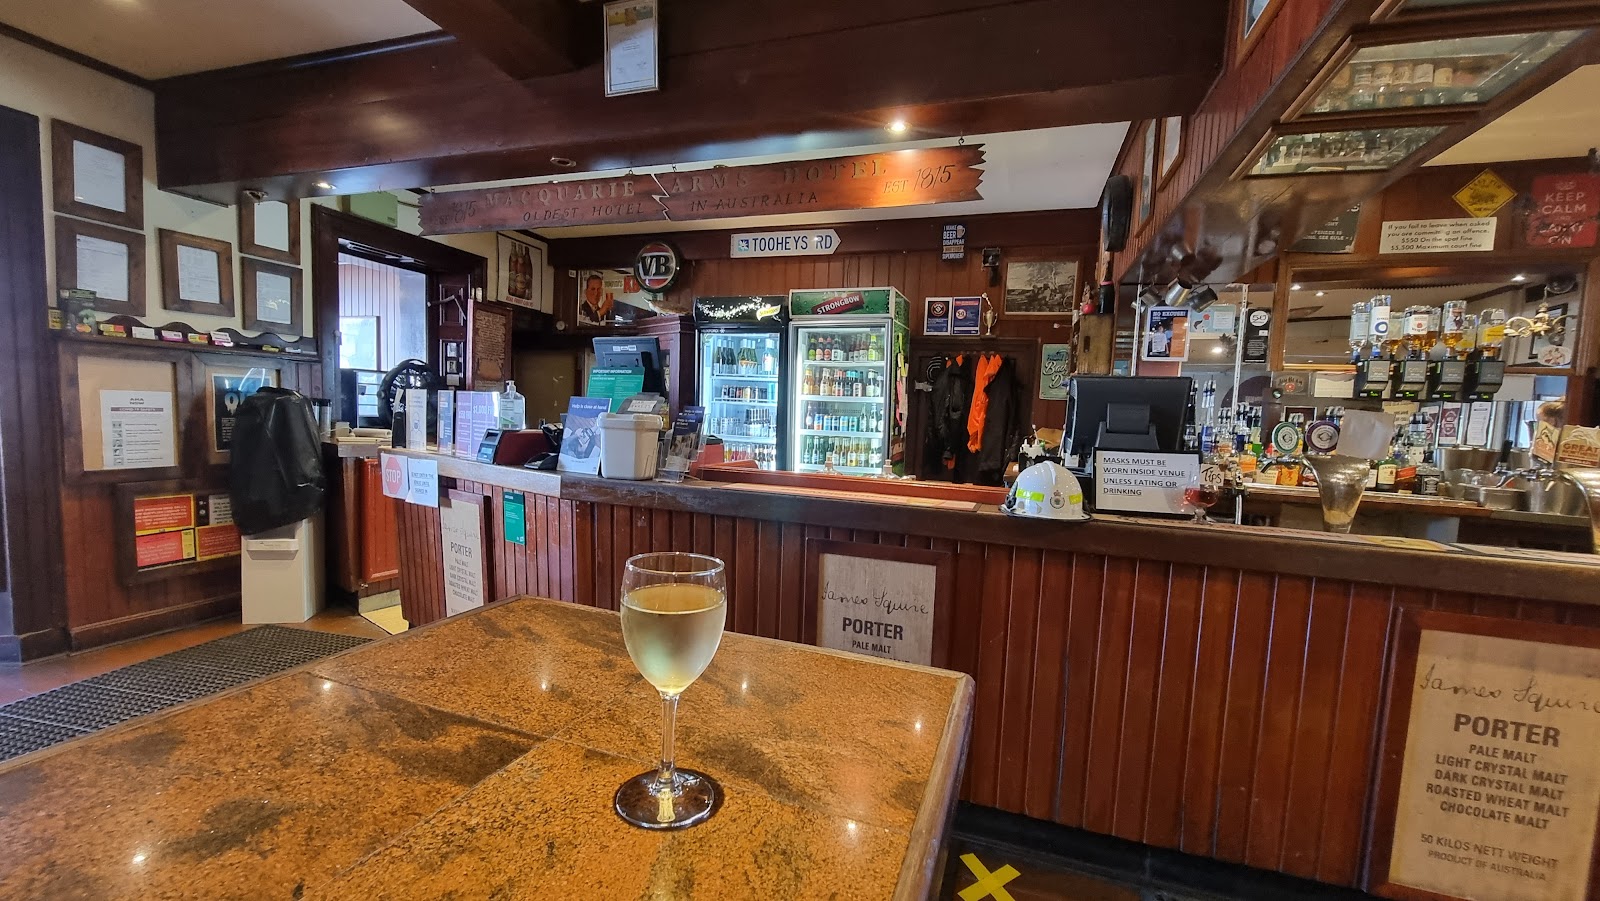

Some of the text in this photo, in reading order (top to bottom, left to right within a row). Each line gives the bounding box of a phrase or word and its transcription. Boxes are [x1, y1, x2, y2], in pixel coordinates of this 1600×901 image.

[670, 158, 887, 193] ARMS HOTEL
[884, 164, 956, 194] EST 1815
[486, 180, 636, 206] MACQUARIE
[690, 192, 819, 212] IN AUSTRALIA
[1545, 192, 1584, 202] KEEP
[522, 202, 645, 223] OLDEST HOTEL
[1542, 204, 1586, 214] CALM
[752, 234, 833, 252] TOOHEYS RD
[943, 231, 956, 239] BEER
[640, 255, 671, 276] VB
[816, 294, 860, 314] STRONGBOW
[1563, 443, 1598, 453] GREAT
[385, 468, 400, 483] STOP
[1201, 466, 1222, 484] Tips
[450, 541, 472, 558] PORTER
[822, 581, 928, 614] James Squire
[842, 616, 904, 640] PORTER
[852, 640, 891, 654] PALE MALT
[1419, 663, 1501, 699] James
[1453, 713, 1561, 748] PORTER
[1469, 744, 1538, 764] PALE MALT
[1435, 754, 1569, 786] LIGHT CRYSTAL MALT
[1434, 769, 1565, 800] DARK CRYSTAL MALT
[1426, 783, 1570, 818] ROASTED WHEAT MALT
[1440, 800, 1550, 830] CHOCOLATE MALT
[1420, 833, 1560, 869] 50 KILOS NETT WEIGHT
[1428, 849, 1546, 881] PRODUCT OF AUSTRALIA
